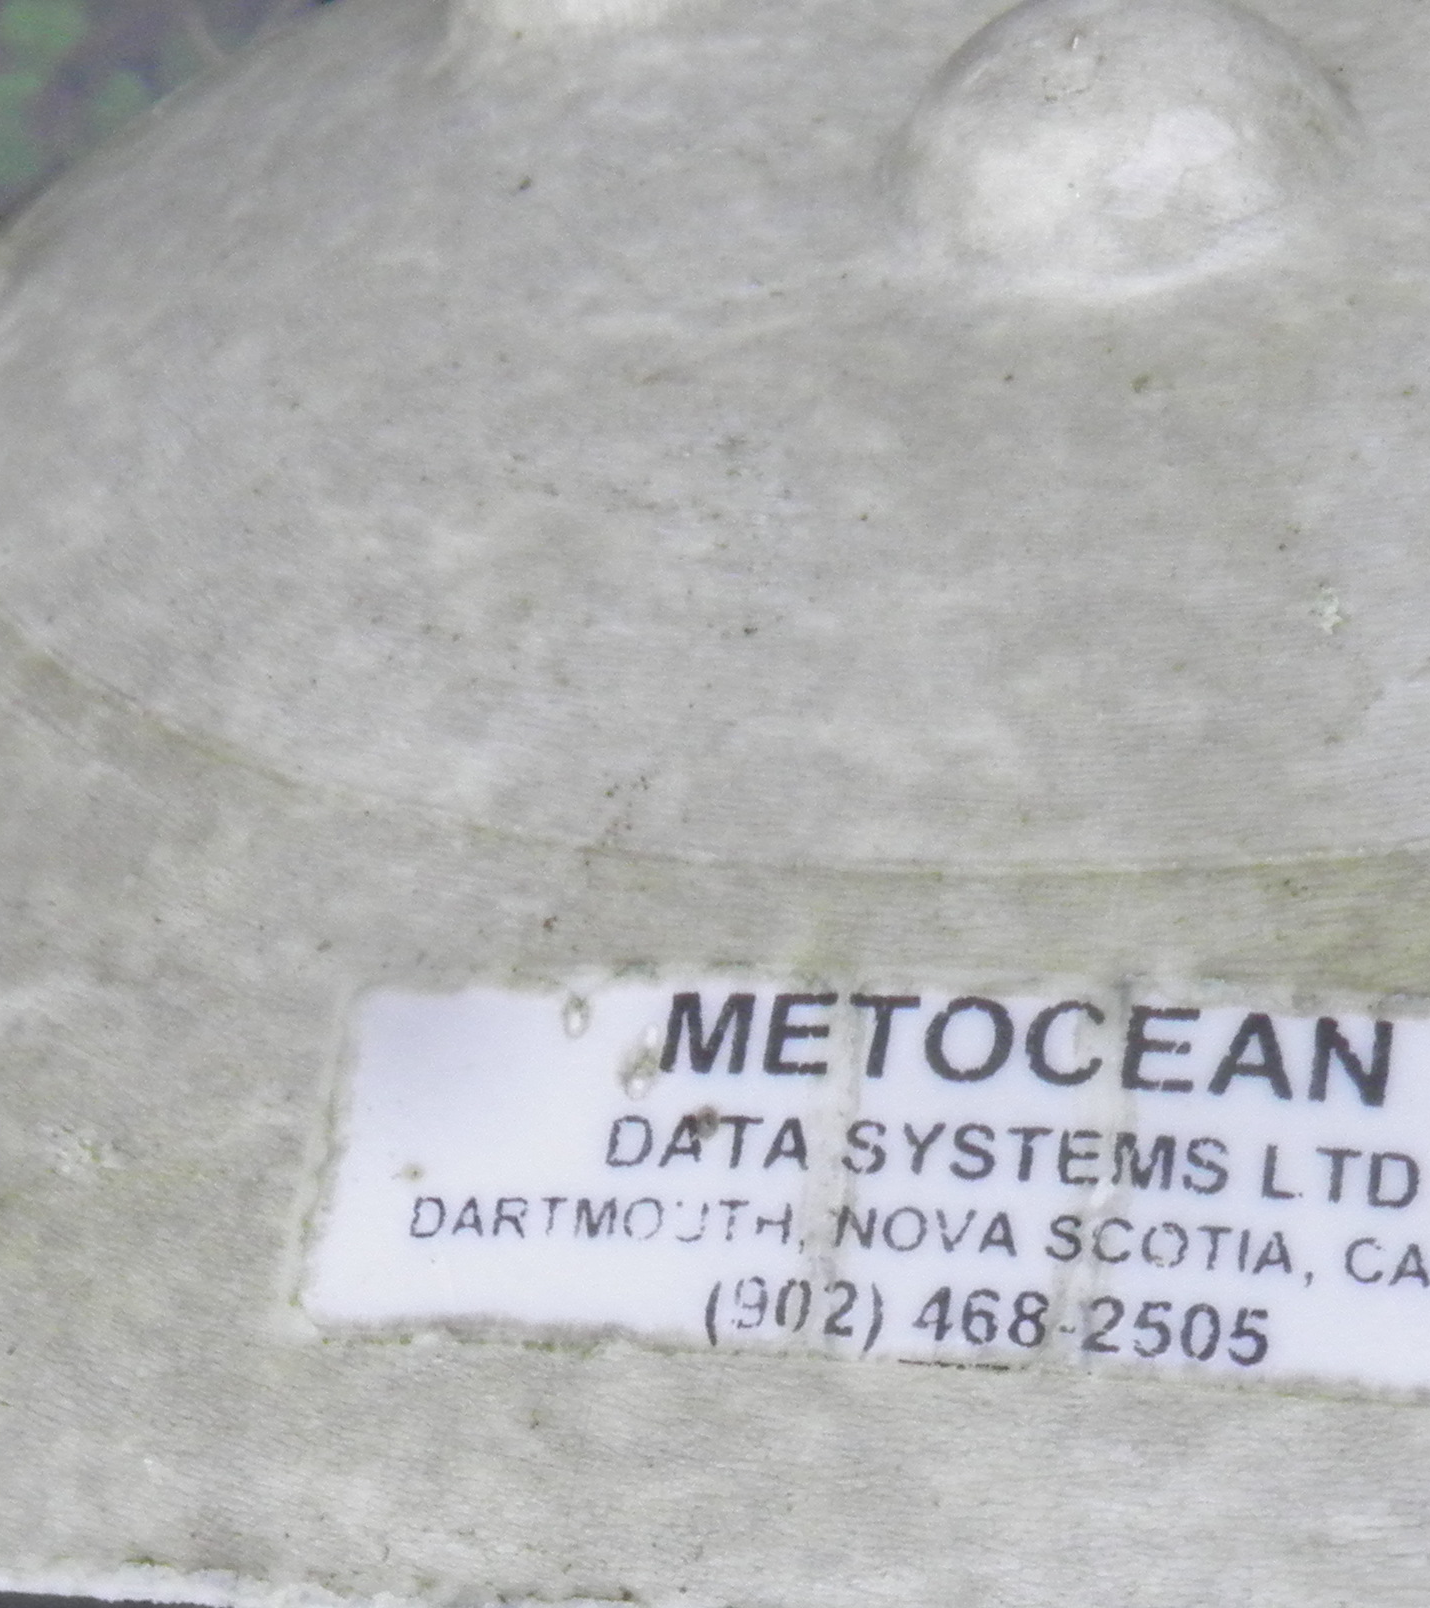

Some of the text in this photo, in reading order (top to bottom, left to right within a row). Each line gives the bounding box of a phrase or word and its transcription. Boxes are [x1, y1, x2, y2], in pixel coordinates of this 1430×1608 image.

[658, 991, 1394, 1108] METOCEAN
[605, 1114, 1421, 1208] DATA SYSTEMS LTD
[831, 1205, 1017, 1259] NOVA
[1045, 1214, 1315, 1288] SCOTIA,
[704, 1275, 884, 1359] (902)
